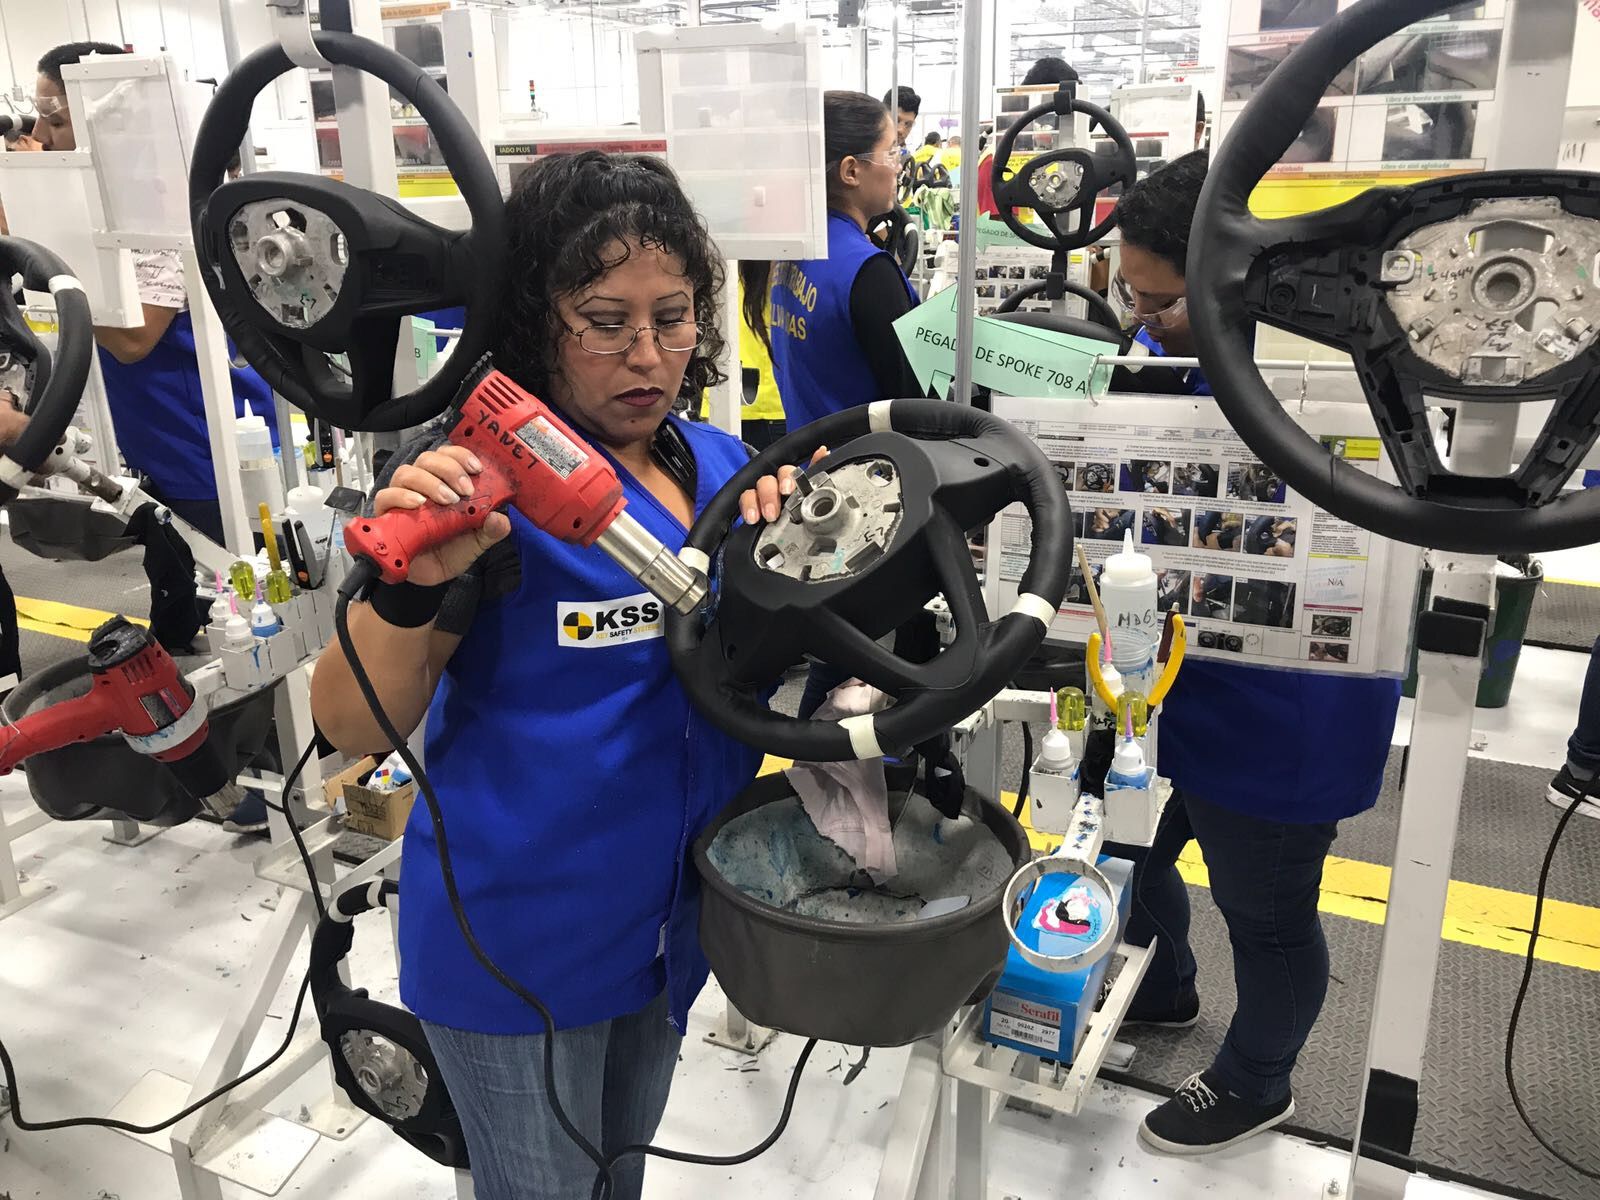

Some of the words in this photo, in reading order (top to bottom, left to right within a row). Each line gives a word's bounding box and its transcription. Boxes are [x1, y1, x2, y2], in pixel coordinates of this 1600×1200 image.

[414, 347, 421, 358] B
[915, 326, 957, 352] PEGAD
[975, 346, 993, 363] DE
[997, 353, 1043, 380] SPOKE
[1048, 369, 1074, 389] 708
[1075, 380, 1087, 394] A
[1327, 578, 1344, 587] N/A
[595, 602, 660, 632] KSS
[595, 632, 608, 640] KEY
[609, 628, 634, 638] SAFETY
[1021, 1003, 1060, 1022] Serafil
